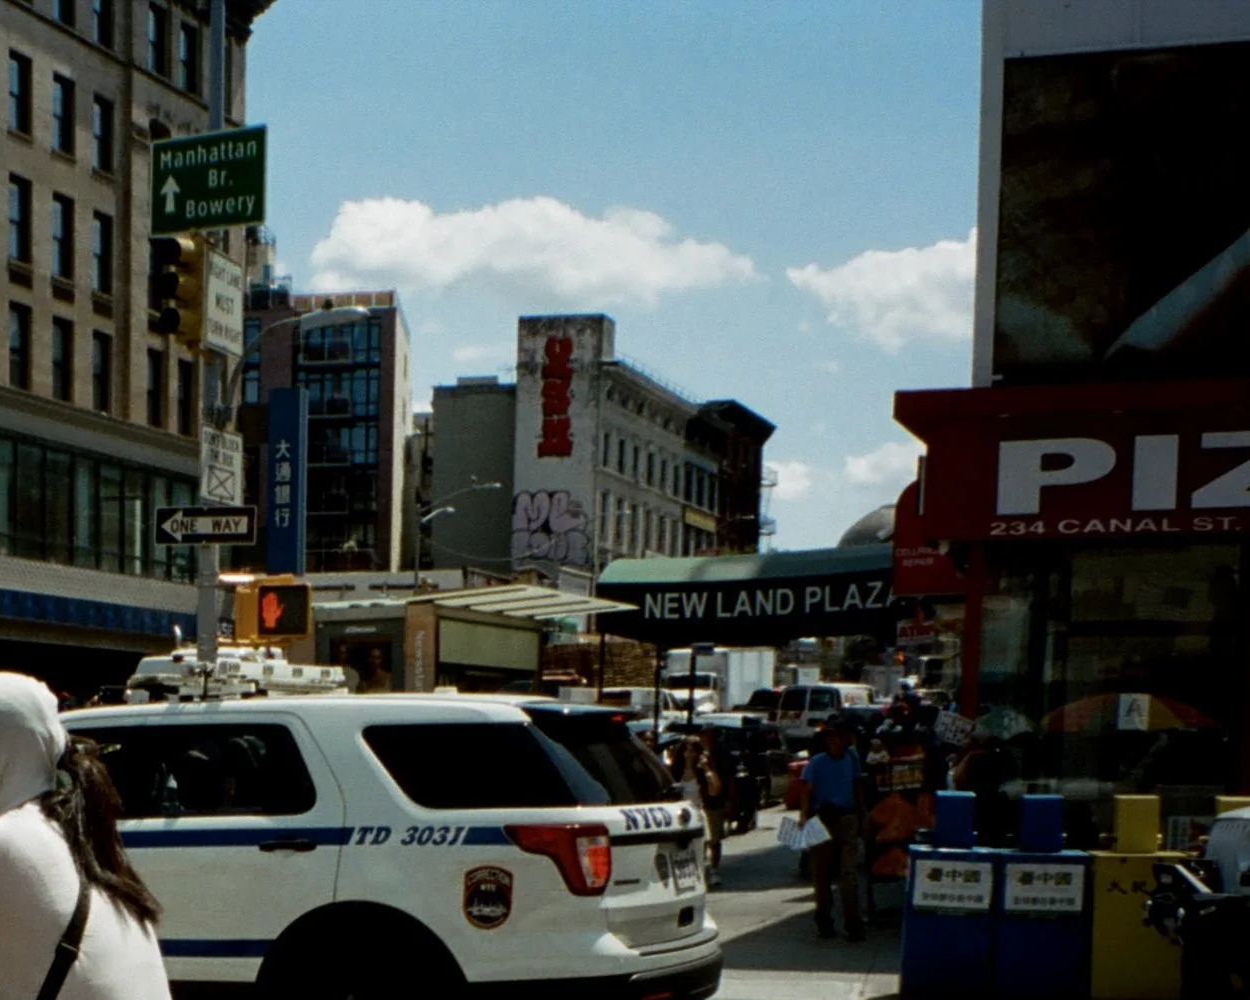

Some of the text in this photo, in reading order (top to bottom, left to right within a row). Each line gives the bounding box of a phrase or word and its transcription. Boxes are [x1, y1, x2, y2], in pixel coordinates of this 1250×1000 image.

[160, 140, 257, 170] Manhattan
[208, 168, 233, 188] Br.
[186, 194, 255, 220] Bowery
[170, 518, 242, 533] ONE WAY
[990, 516, 1241, 536] 234 CANAL ST.
[643, 591, 709, 620] NEW
[717, 587, 795, 618] LAND
[622, 806, 672, 831] NYCD
[355, 826, 392, 846] TD
